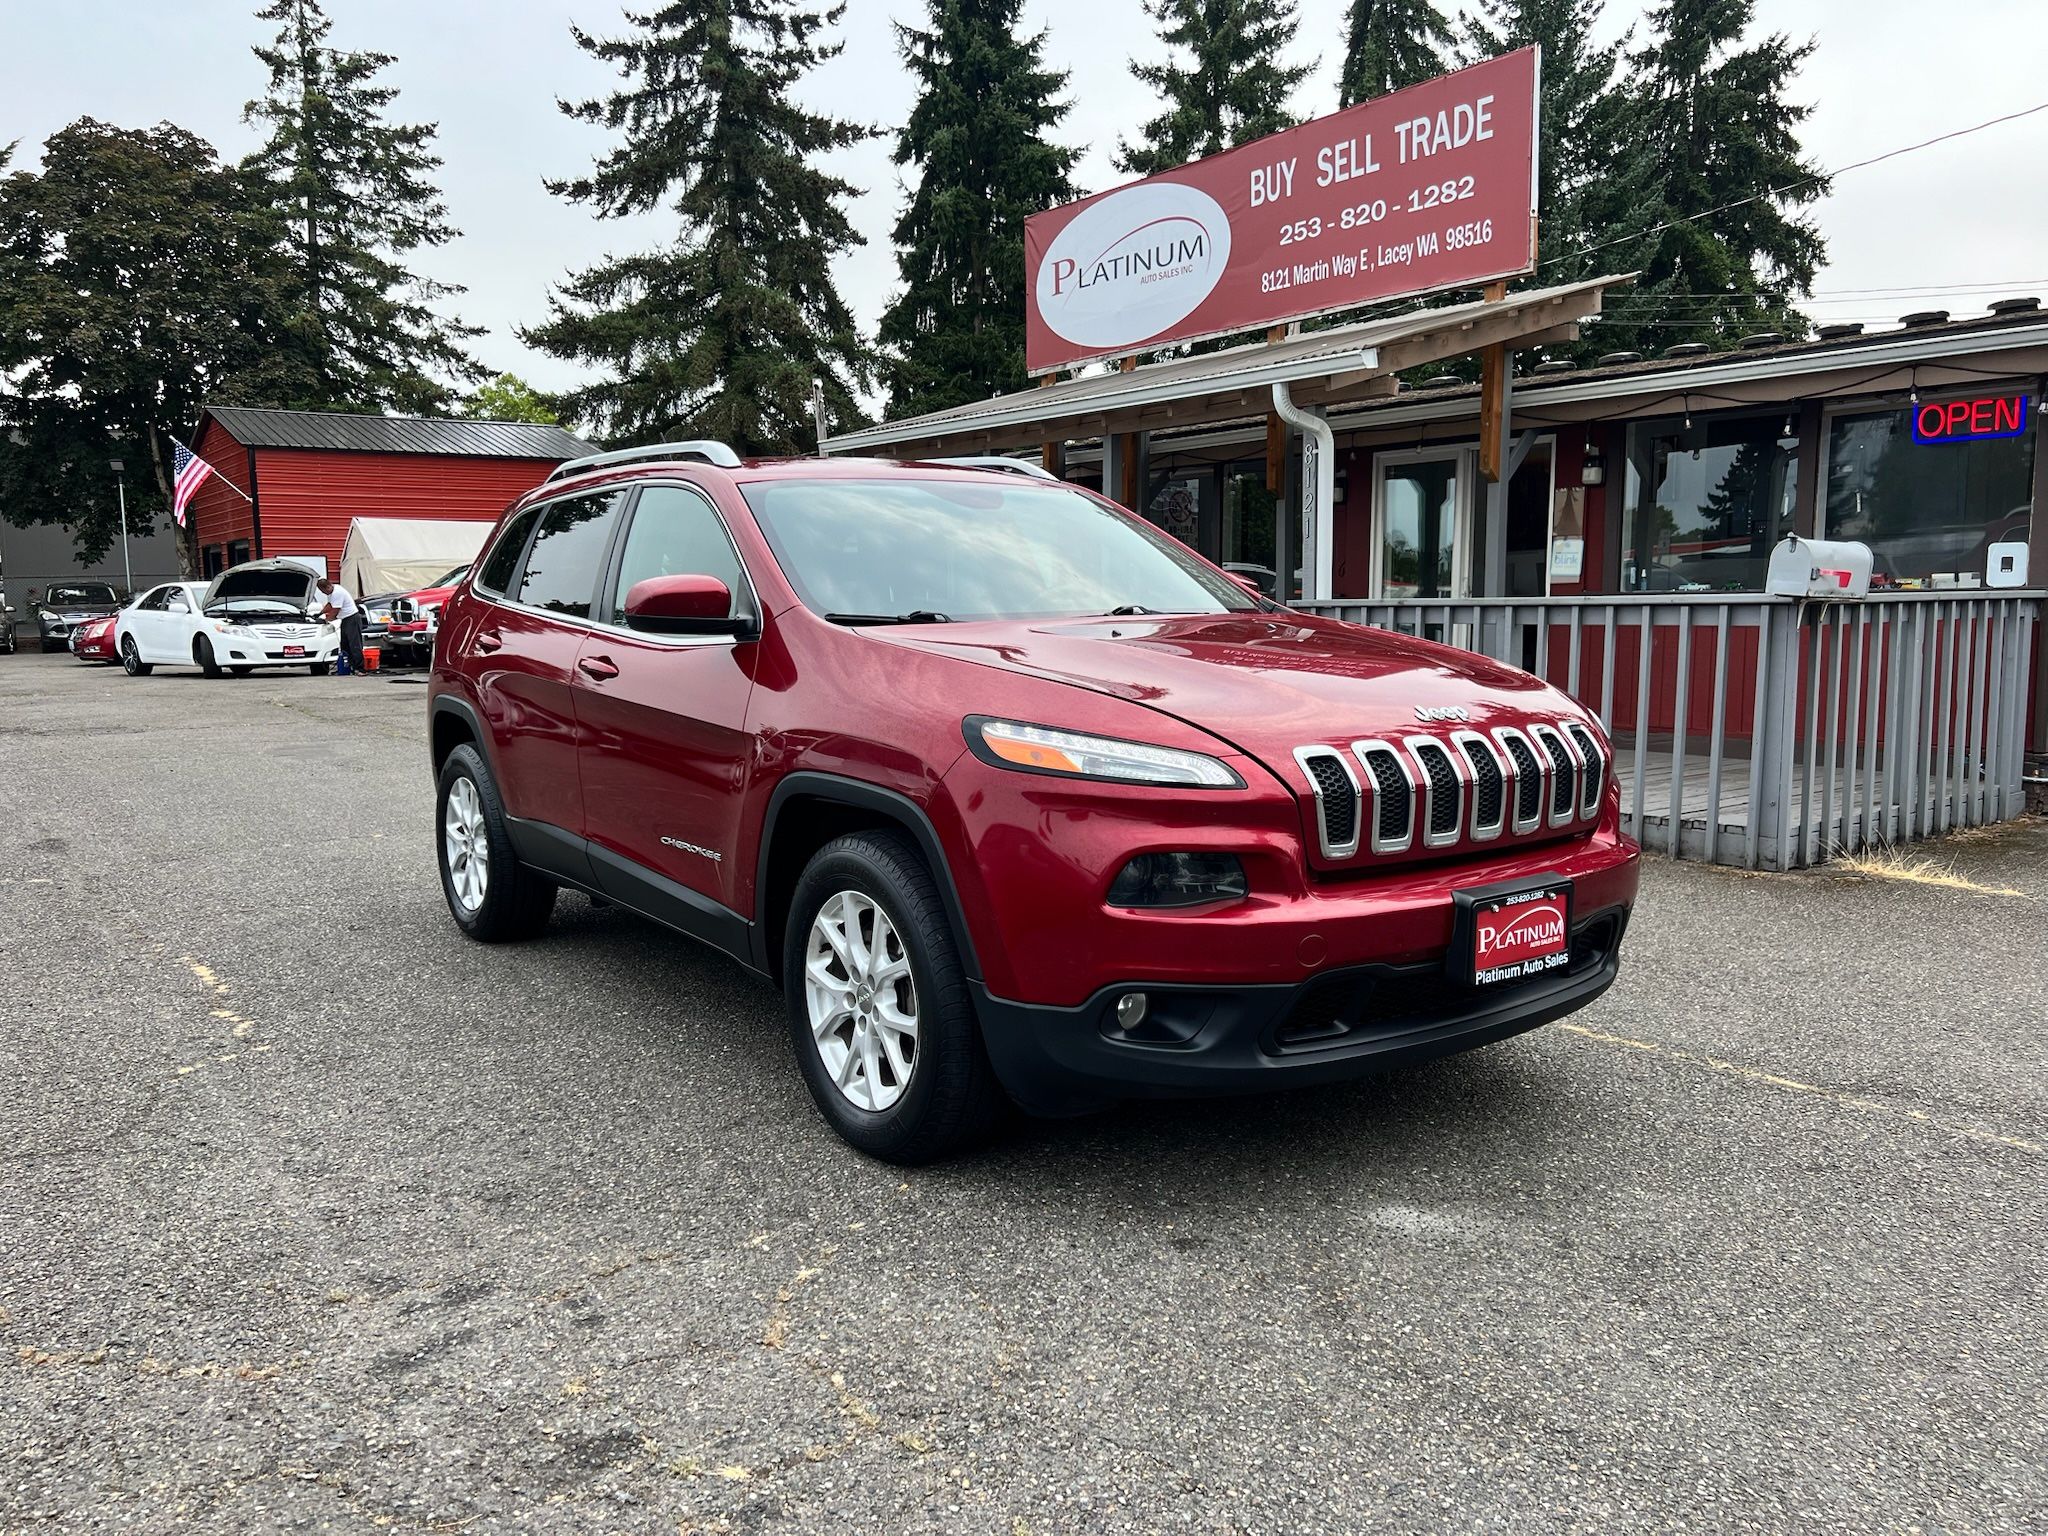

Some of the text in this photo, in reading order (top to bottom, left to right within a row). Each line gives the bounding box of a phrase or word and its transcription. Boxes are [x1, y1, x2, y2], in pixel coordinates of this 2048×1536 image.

[1250, 94, 1494, 208] BUY SELL TRADE
[1279, 216, 1322, 246] 253
[1340, 200, 1387, 230] 820
[1407, 175, 1475, 214] 1282
[1051, 234, 1204, 297] PLATINUM
[1261, 267, 1291, 293] 8121
[1293, 259, 1329, 286] Martin
[1332, 253, 1358, 279] Way
[1377, 242, 1414, 266] Lacey
[1416, 232, 1439, 258] WA
[1445, 219, 1493, 251] 98516
[1140, 264, 1194, 285] AUTO SALES INC
[1918, 397, 2020, 438] OPEN
[1414, 704, 1469, 722] Jeep
[660, 836, 722, 862] CHEROKEE
[1505, 891, 1545, 905] 253-820-1282
[1478, 921, 1564, 954] PLATINUM
[1475, 953, 1569, 985] Platinum Auto Sales
